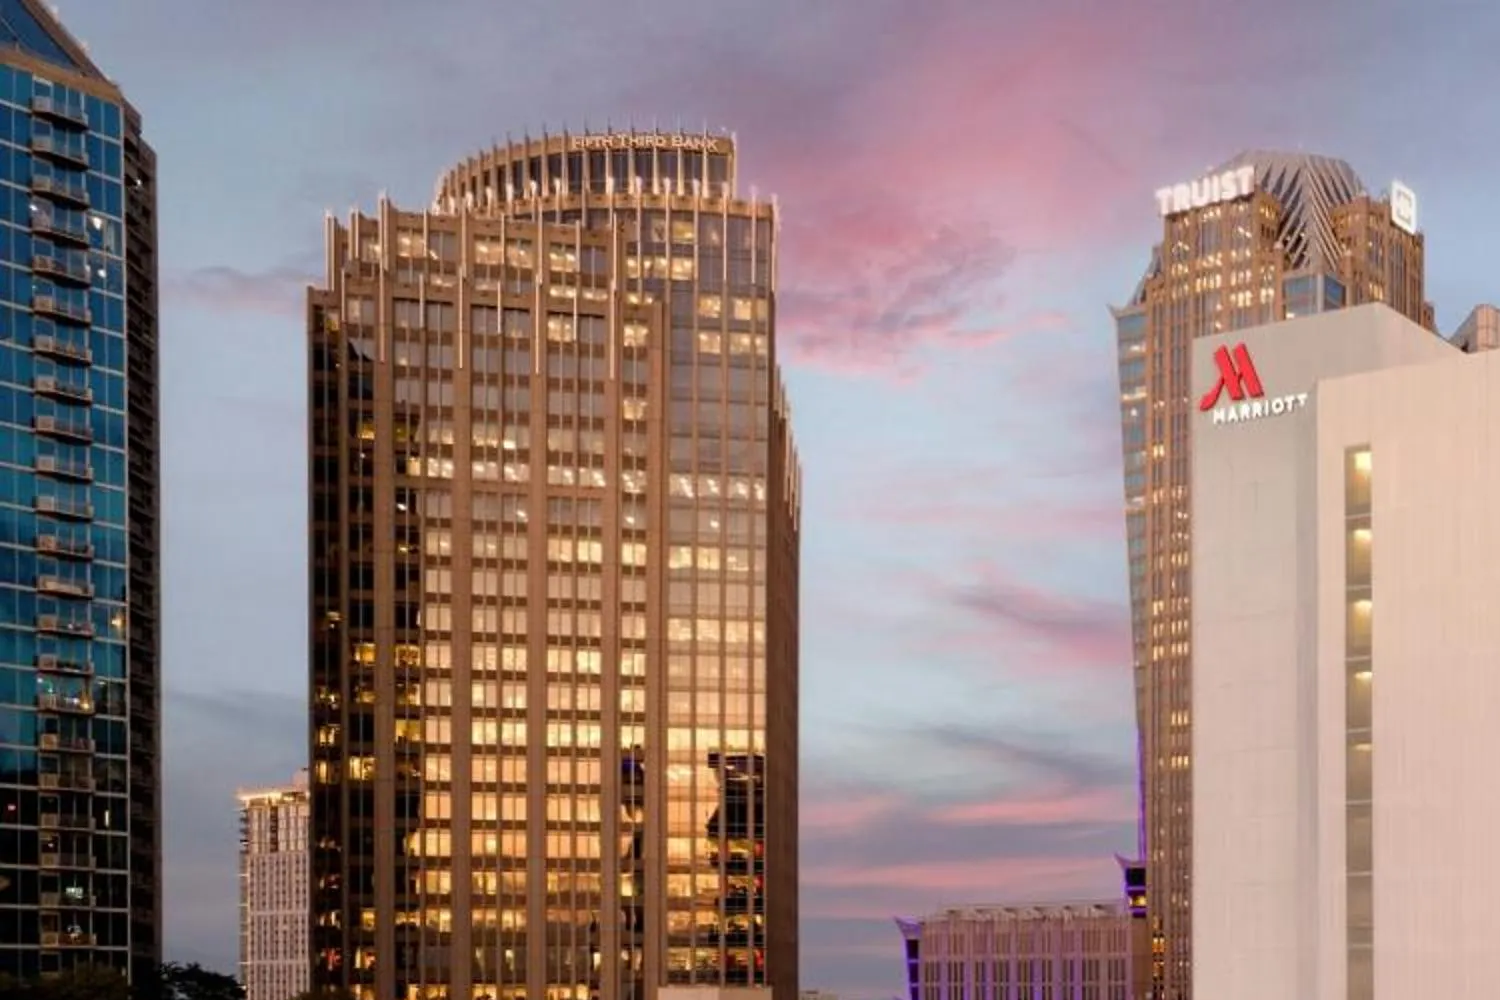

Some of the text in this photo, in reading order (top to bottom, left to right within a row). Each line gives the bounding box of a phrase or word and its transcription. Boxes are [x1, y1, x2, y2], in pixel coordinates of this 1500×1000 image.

[573, 134, 719, 153] FIFTH THIRD BANK
[1155, 165, 1255, 216] TRUIST
[1213, 393, 1308, 424] MARRIOTT
